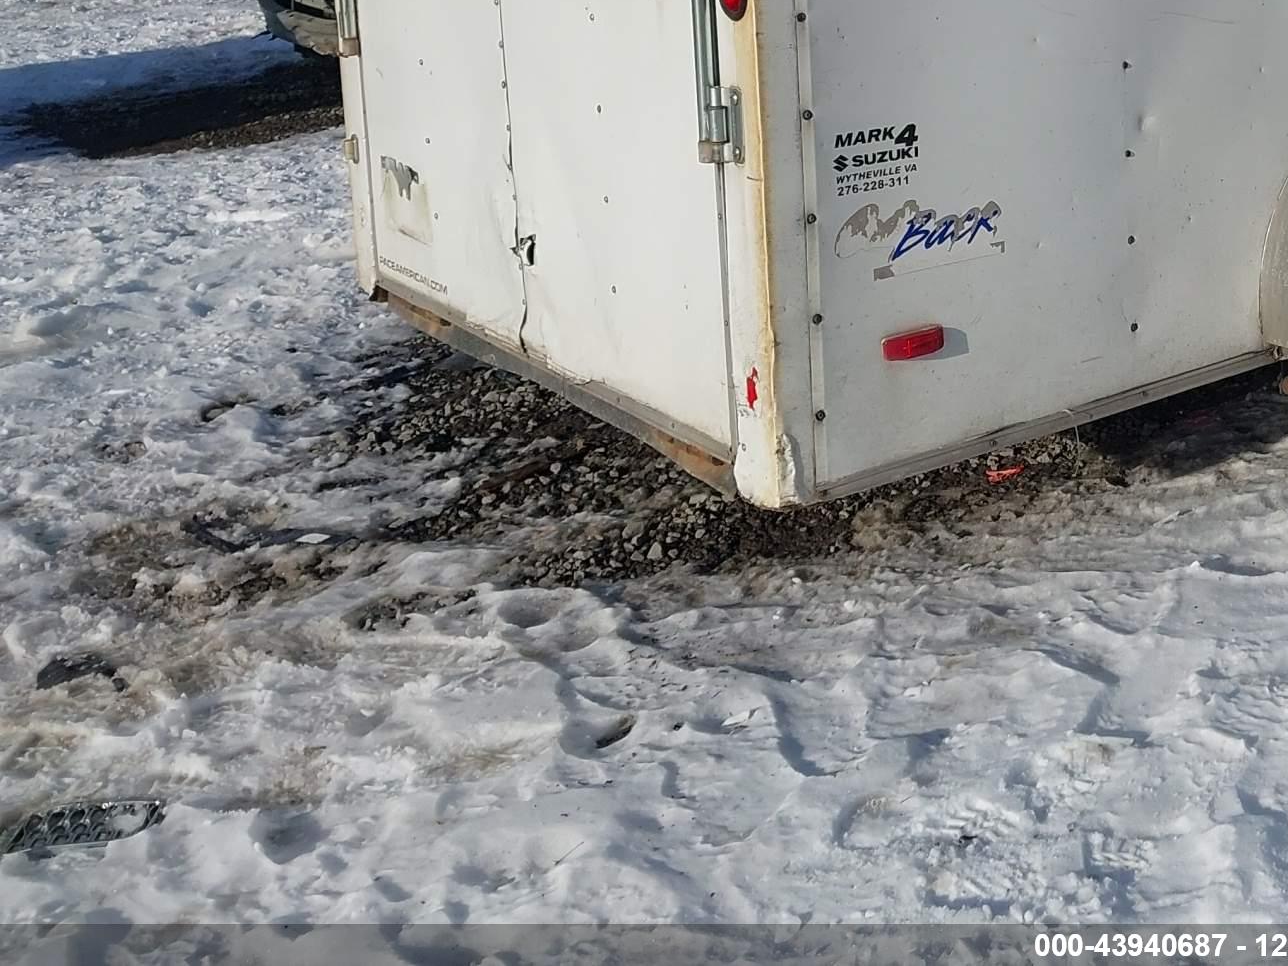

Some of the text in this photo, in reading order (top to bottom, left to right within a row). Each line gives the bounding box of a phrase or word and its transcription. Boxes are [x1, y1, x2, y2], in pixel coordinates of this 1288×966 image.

[851, 145, 919, 168] SUZUKI
[835, 163, 918, 184] WYTHEVILLE VA
[837, 175, 910, 197] 276-228-311
